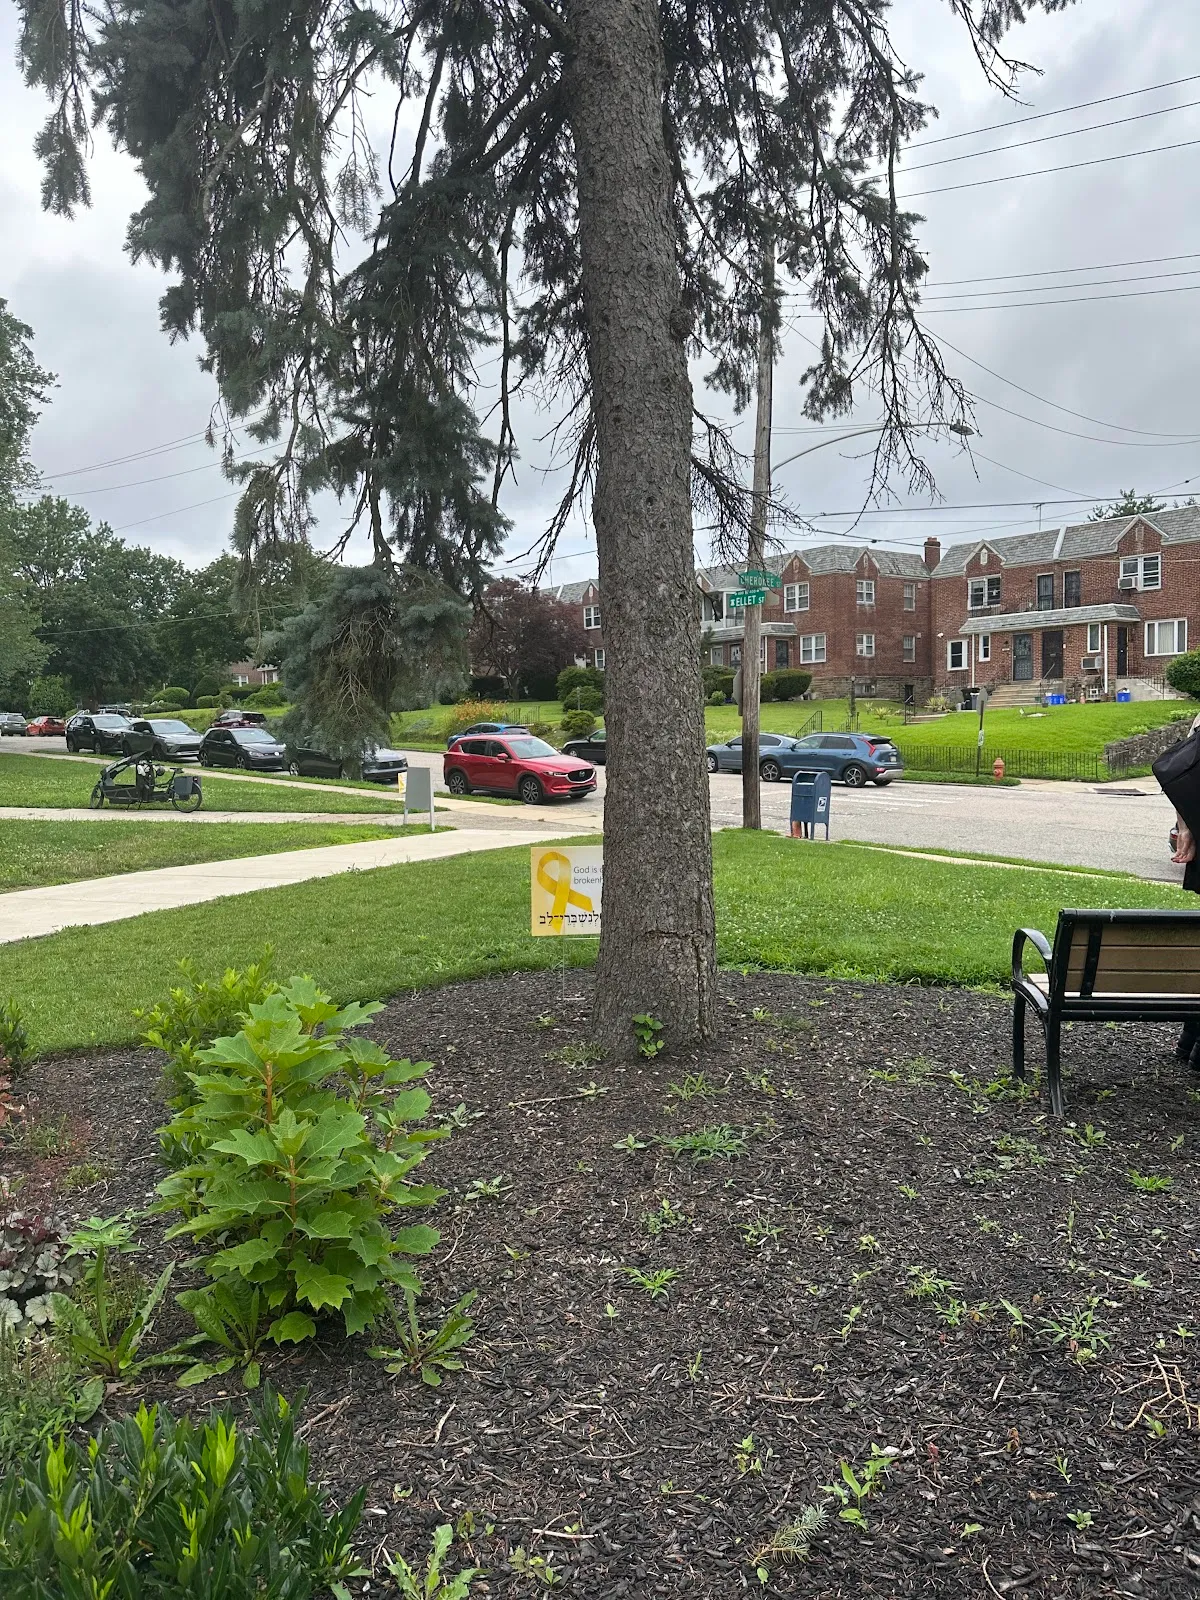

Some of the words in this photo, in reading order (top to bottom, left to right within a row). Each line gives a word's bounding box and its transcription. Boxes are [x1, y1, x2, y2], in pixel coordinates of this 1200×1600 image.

[740, 575, 774, 587] CHEROKEE
[735, 595, 757, 607] ELLET
[758, 596, 765, 604] ST
[573, 866, 590, 874] God
[592, 866, 598, 874] is
[573, 876, 603, 885] brokenh
